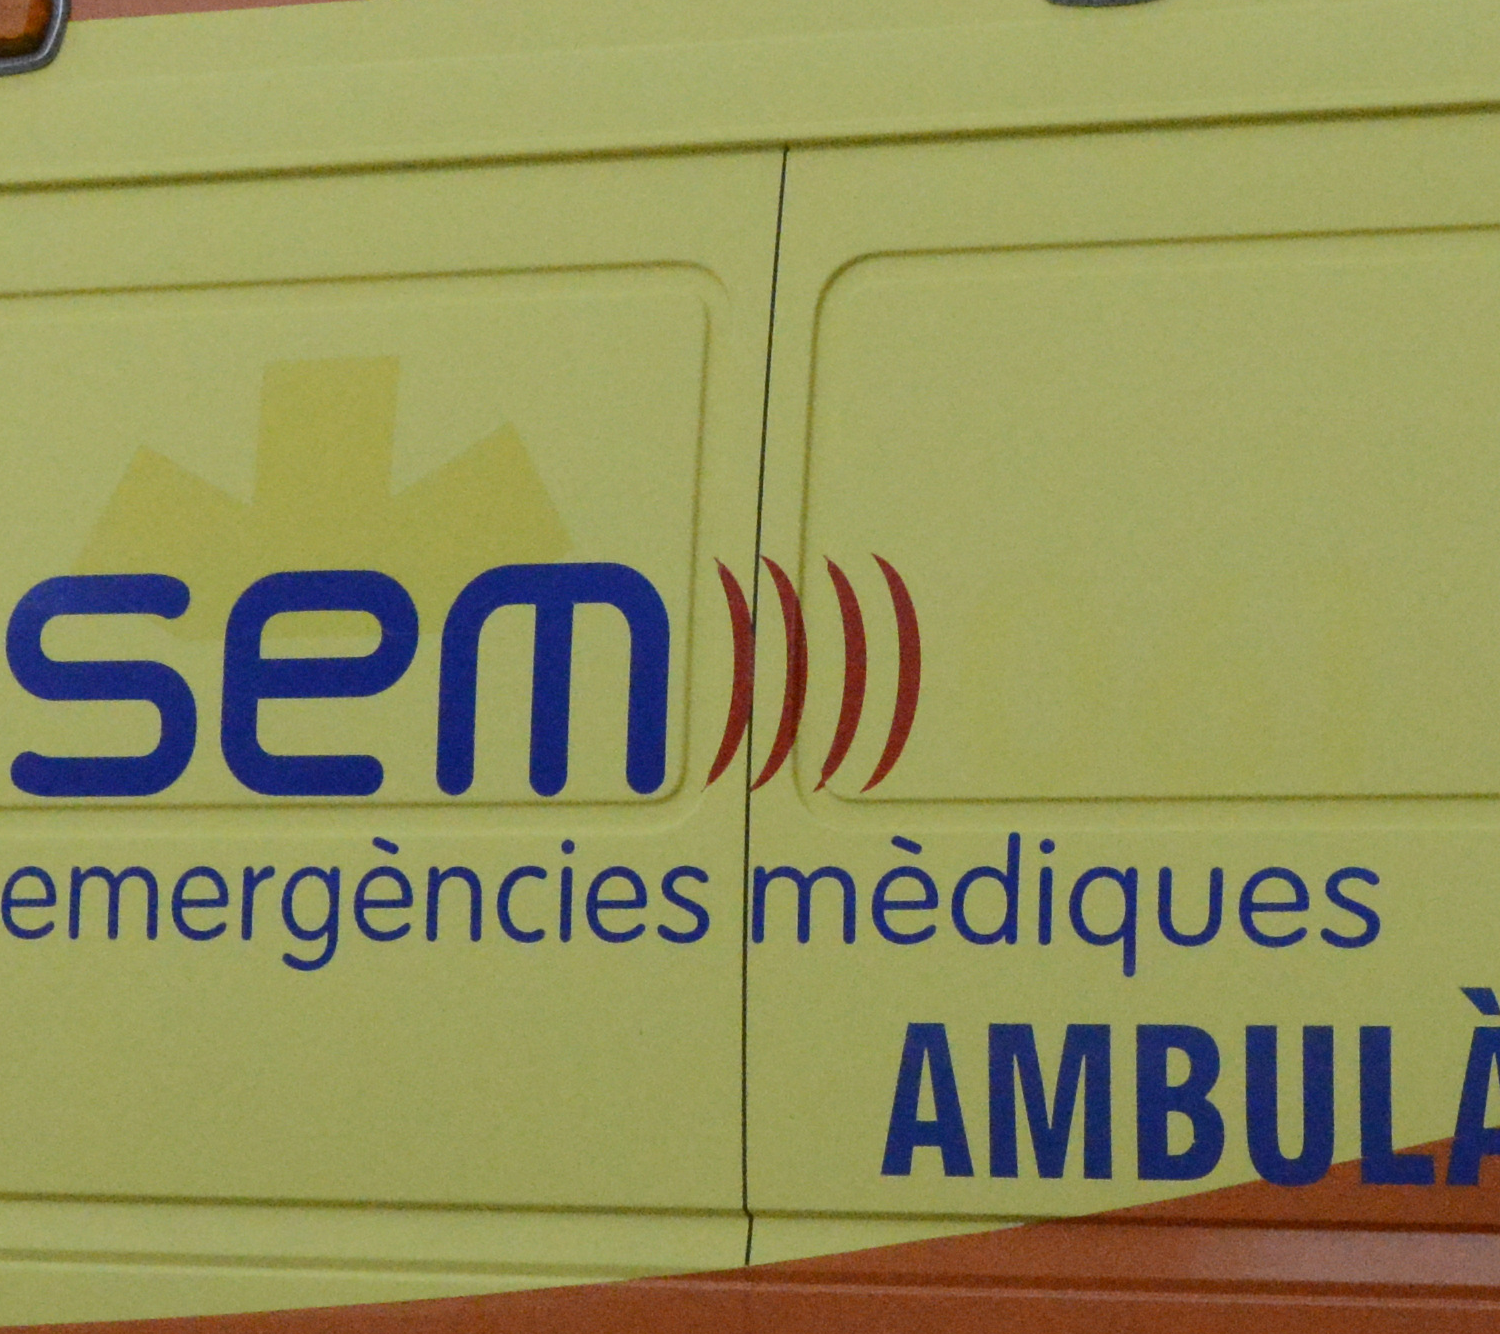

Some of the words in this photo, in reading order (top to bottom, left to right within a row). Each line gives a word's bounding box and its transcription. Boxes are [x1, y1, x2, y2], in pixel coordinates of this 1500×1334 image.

[4, 560, 671, 798] sem
[0, 835, 711, 971] emergències
[750, 831, 1382, 978] mèdiques
